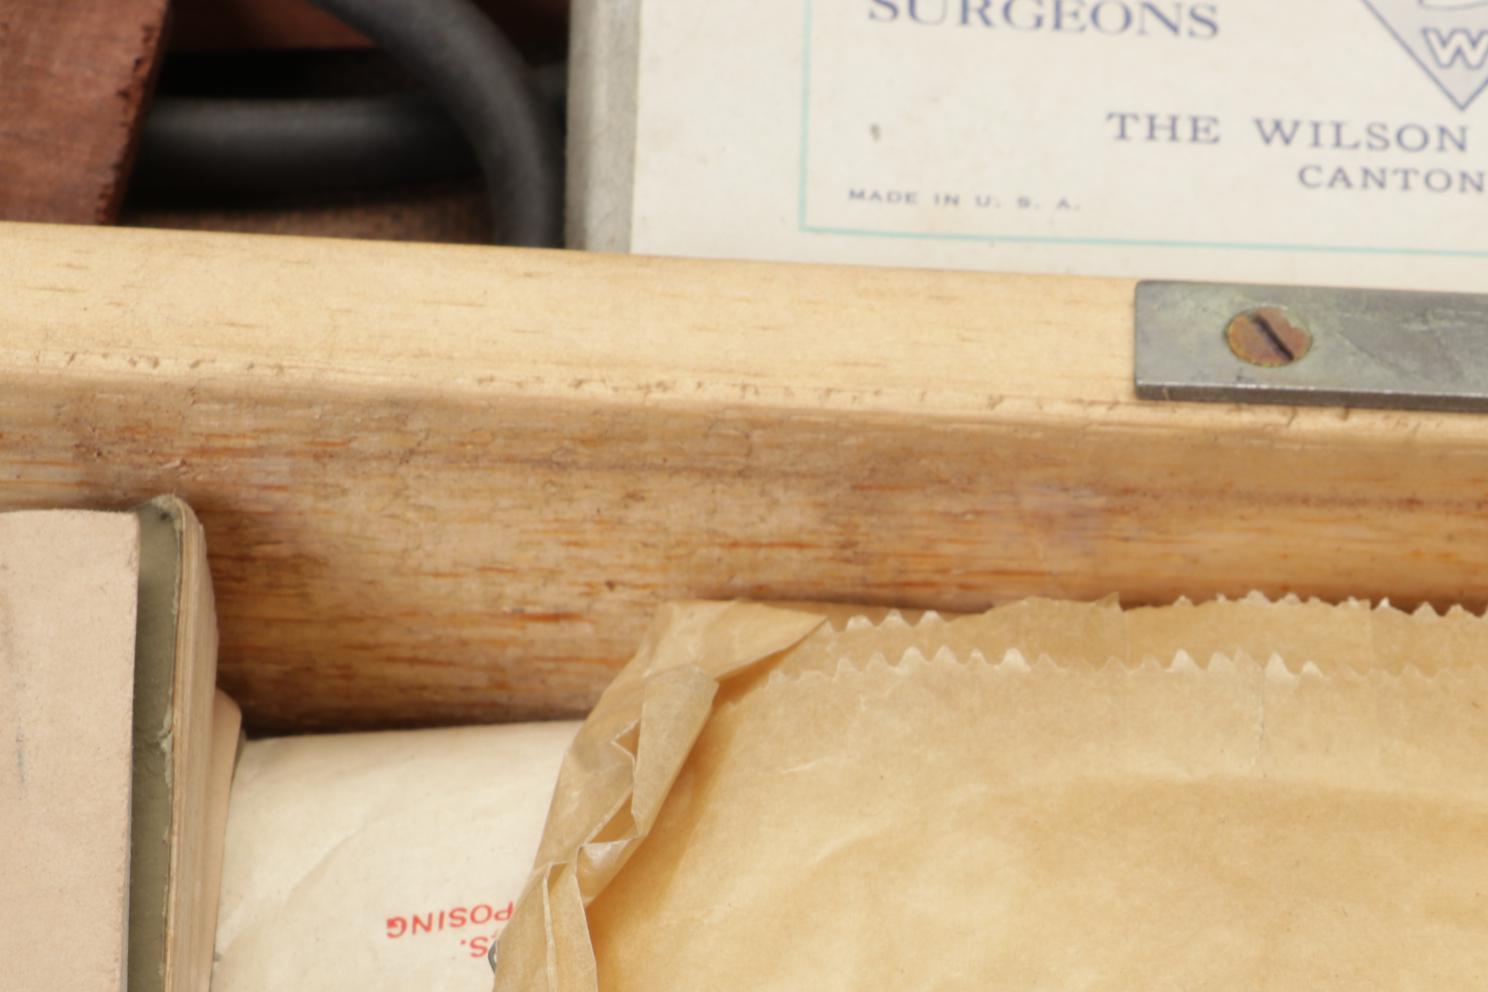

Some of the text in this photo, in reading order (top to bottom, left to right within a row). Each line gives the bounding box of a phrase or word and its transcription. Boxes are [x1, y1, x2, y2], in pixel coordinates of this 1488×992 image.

[867, 0, 1221, 40] SURGEONS
[1105, 111, 1222, 145] THE
[1253, 116, 1469, 154] WILSON
[848, 187, 919, 206] MADE
[933, 191, 961, 207] IN
[386, 901, 513, 938] POSING
